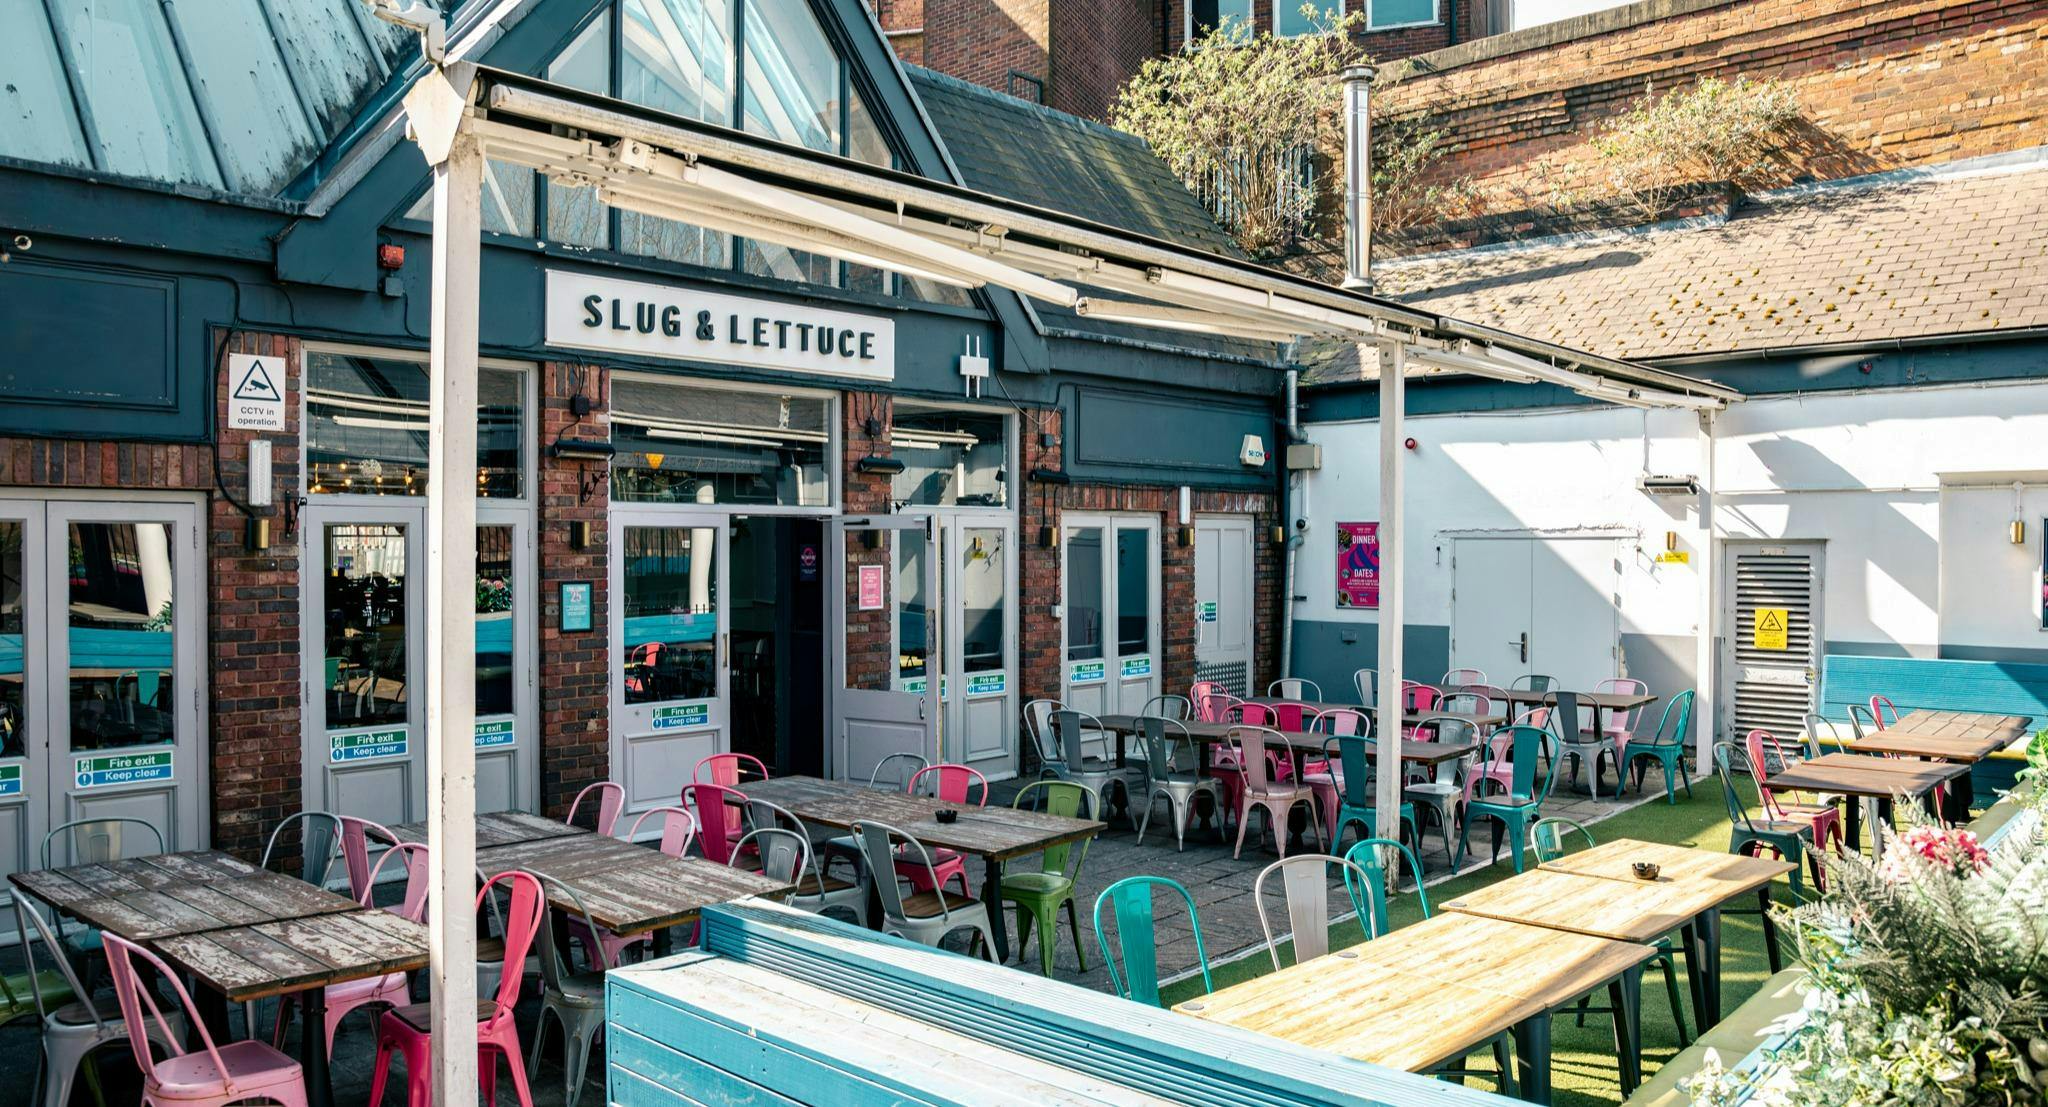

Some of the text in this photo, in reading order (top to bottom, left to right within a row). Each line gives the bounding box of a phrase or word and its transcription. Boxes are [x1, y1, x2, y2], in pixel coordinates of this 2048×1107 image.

[583, 295, 875, 359] SLUG & LETTUCE
[241, 407, 264, 415] CCTV
[237, 418, 277, 426] operation
[1352, 535, 1376, 544] DINNER
[1354, 569, 1373, 578] DATES
[669, 718, 685, 726] Keep
[486, 723, 502, 732] exit
[357, 734, 393, 745] Fire exit
[486, 735, 505, 743] clear
[353, 744, 397, 756] Keep clear
[109, 756, 155, 768] Fire exit
[105, 768, 160, 781] Keep clear
